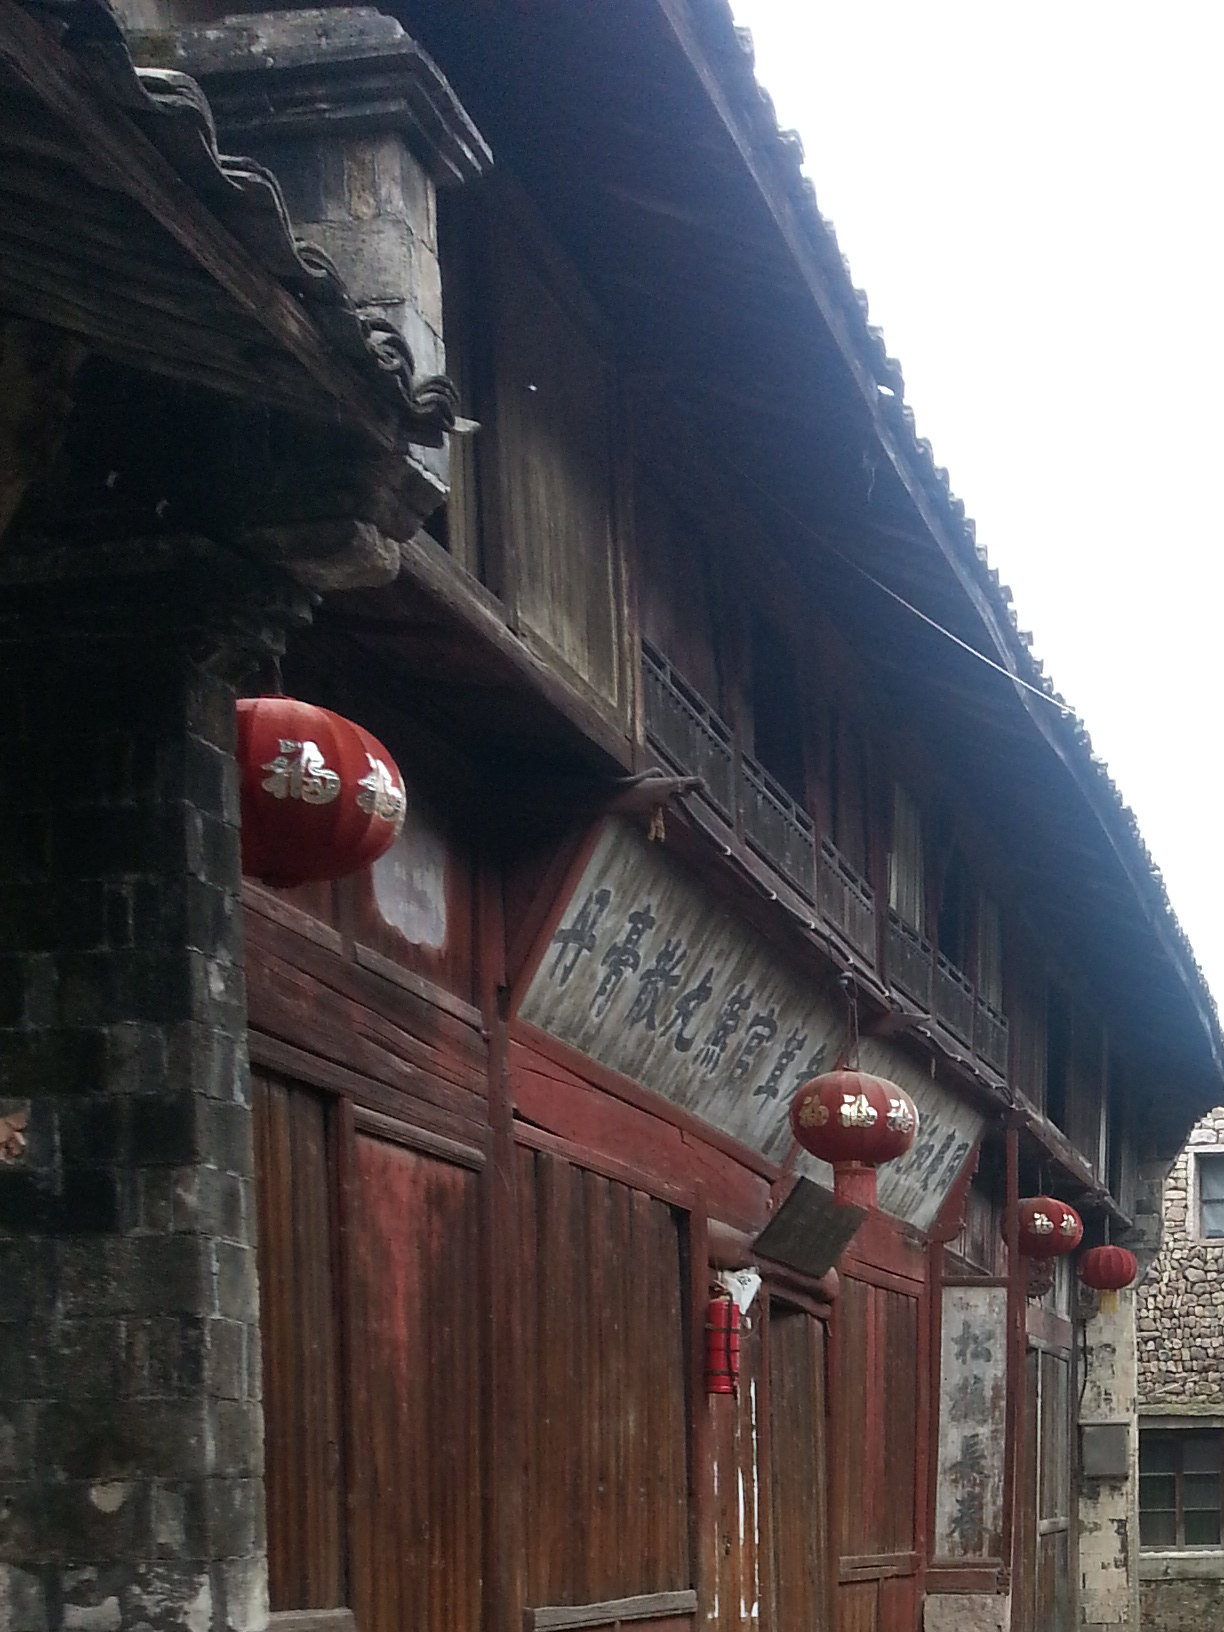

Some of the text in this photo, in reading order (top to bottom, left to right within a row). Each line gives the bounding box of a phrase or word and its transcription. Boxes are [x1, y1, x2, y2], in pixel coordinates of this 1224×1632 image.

[260, 739, 403, 821] 福 福
[840, 1094, 878, 1128] 福
[887, 1099, 914, 1133] 福
